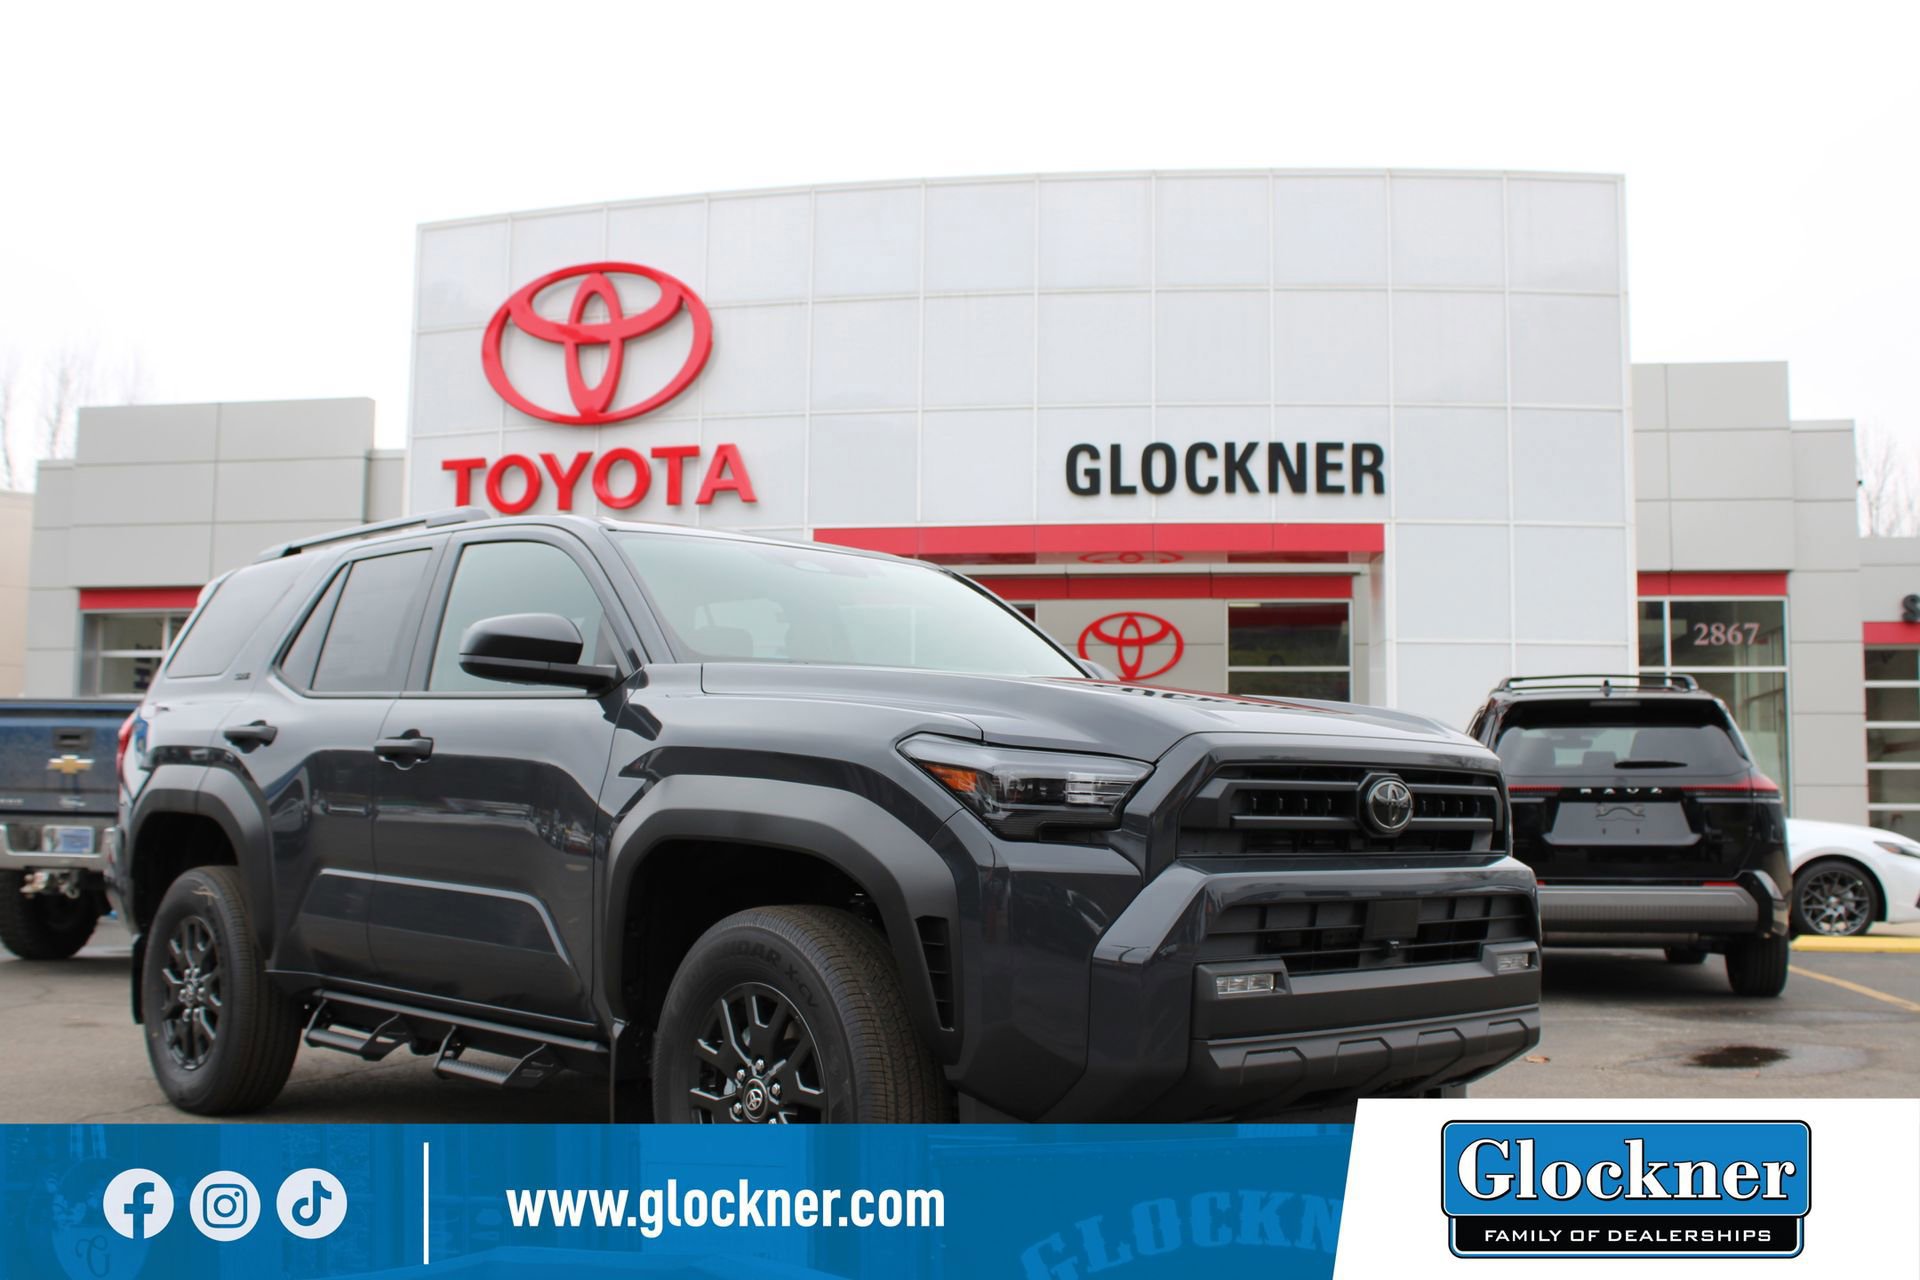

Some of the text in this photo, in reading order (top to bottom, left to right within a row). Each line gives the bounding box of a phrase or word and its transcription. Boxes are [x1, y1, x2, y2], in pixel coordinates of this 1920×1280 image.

[441, 443, 757, 515] TOYOTA
[1065, 441, 1386, 497] GLOCKNER
[1693, 622, 1760, 646] 2867
